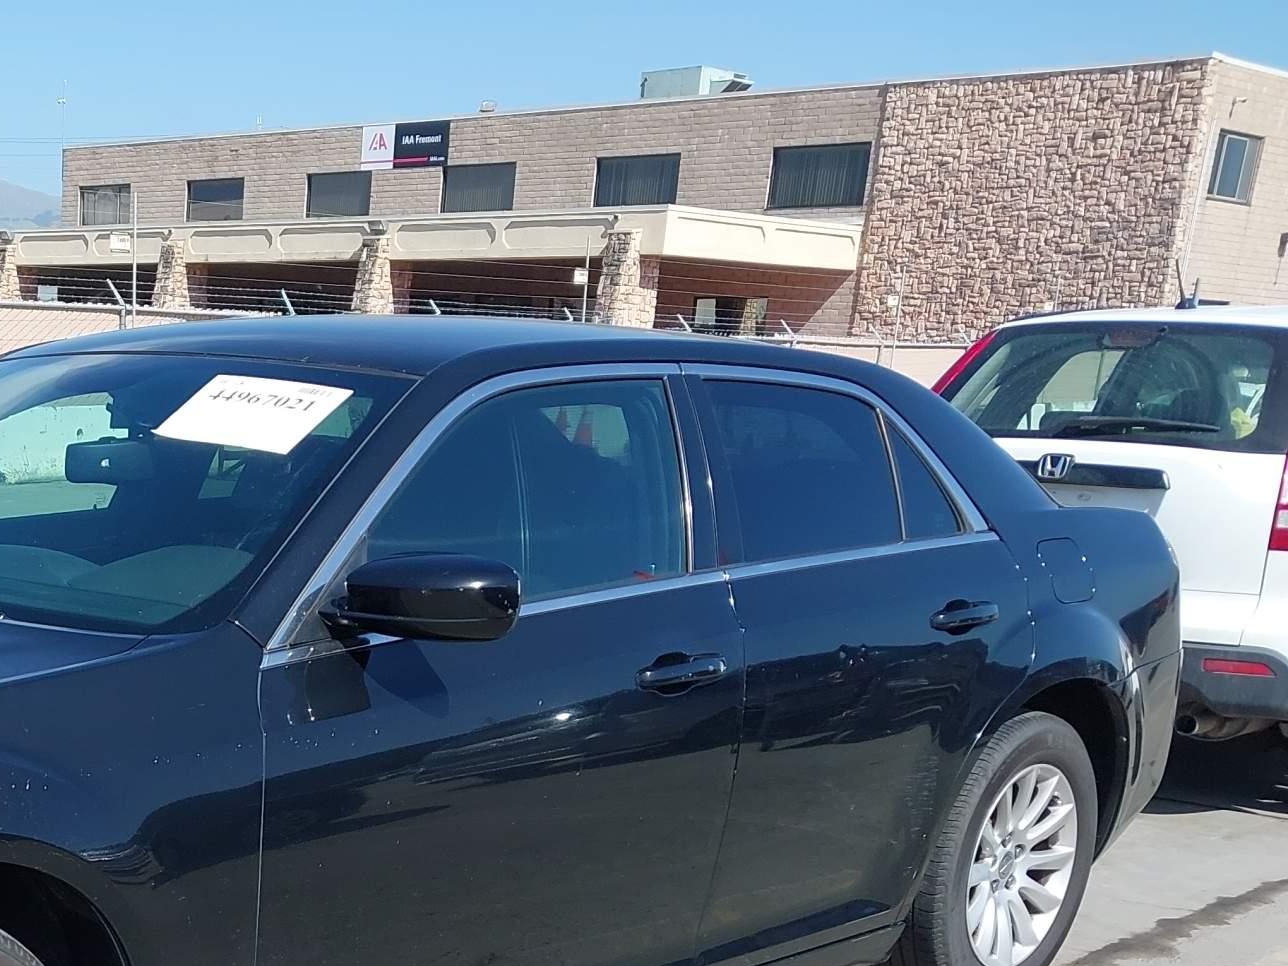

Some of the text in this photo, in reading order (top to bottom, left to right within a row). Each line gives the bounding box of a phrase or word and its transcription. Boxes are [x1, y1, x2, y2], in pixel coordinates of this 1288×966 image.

[402, 134, 442, 145] IAA Fremont
[208, 389, 316, 412] 44967021
